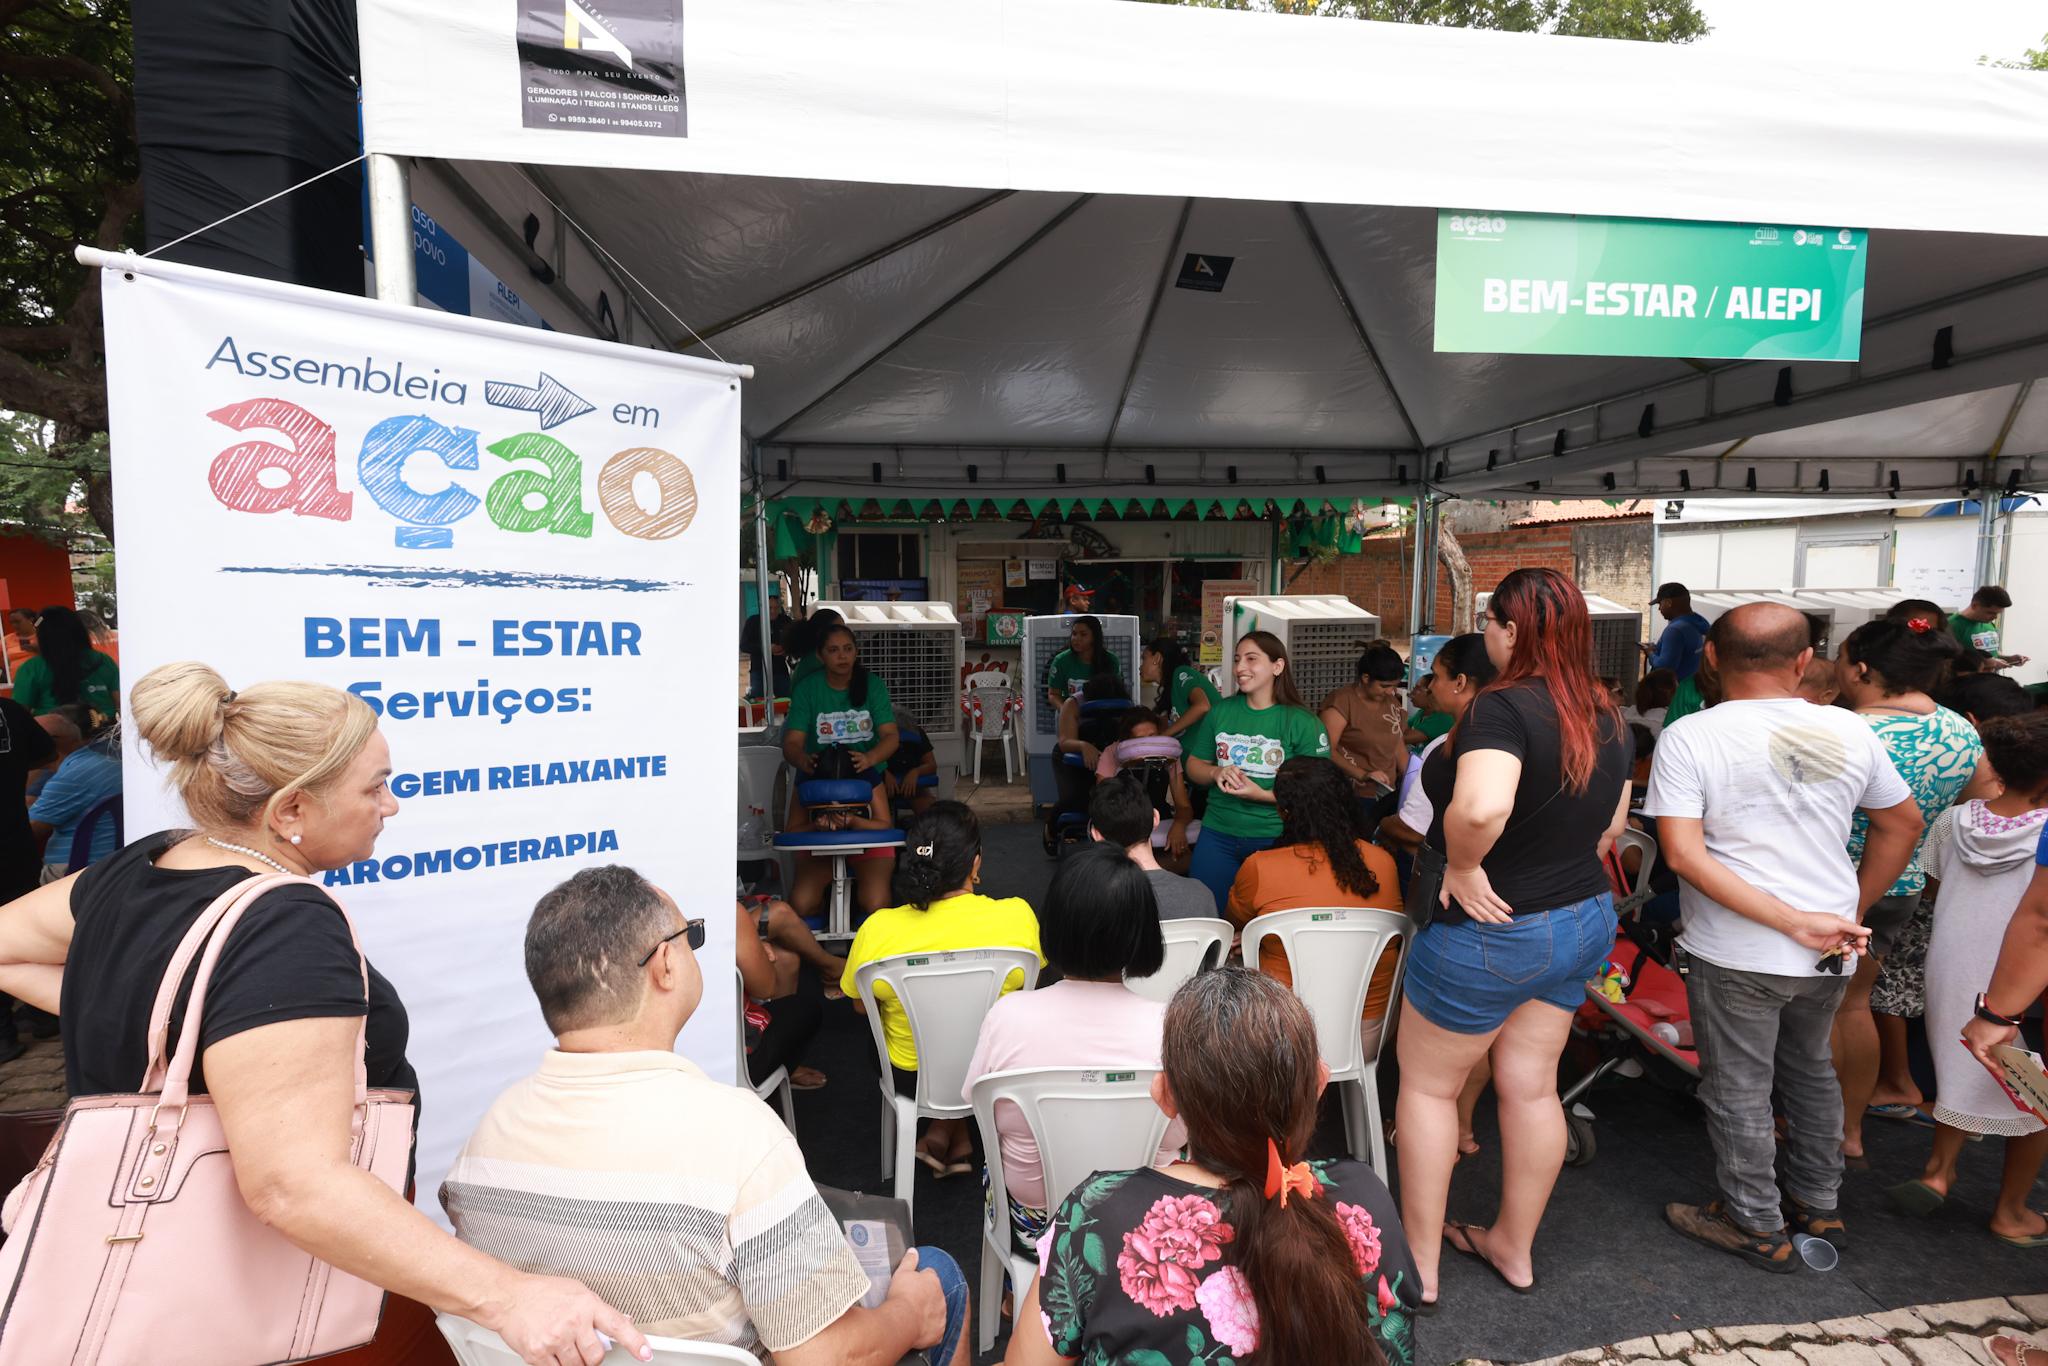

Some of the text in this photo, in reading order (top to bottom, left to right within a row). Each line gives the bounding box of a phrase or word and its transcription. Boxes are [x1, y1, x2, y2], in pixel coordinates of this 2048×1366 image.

[578, 0, 618, 33] UTENTIC
[627, 73, 660, 81] EVENTO
[527, 86, 578, 97] GERADORES
[584, 91, 617, 99] PALCOS
[622, 94, 680, 104] SONORIZAÇÃO
[527, 96, 578, 106] ILUMINAÇÃO
[584, 99, 616, 108] TENDAS
[621, 102, 653, 111] STANDS
[659, 105, 679, 113] LEDS
[412, 205, 436, 236] asa
[413, 229, 446, 266] povo
[497, 282, 520, 310] ALEPI
[1483, 278, 1698, 318] BEM-ESTAR
[1725, 286, 1822, 321] ALEPI
[205, 336, 661, 429] Assembleia em
[960, 569, 997, 579] PROMOÇÃO
[966, 589, 993, 599] PIZZA G
[304, 617, 441, 658] BEM
[492, 620, 642, 657] ESTAR
[346, 679, 592, 725] Serviços:
[386, 755, 667, 799] GEM RELAXANTE
[322, 829, 619, 888] AROMOTERAPIA
[1613, 892, 1645, 912] Quinny
